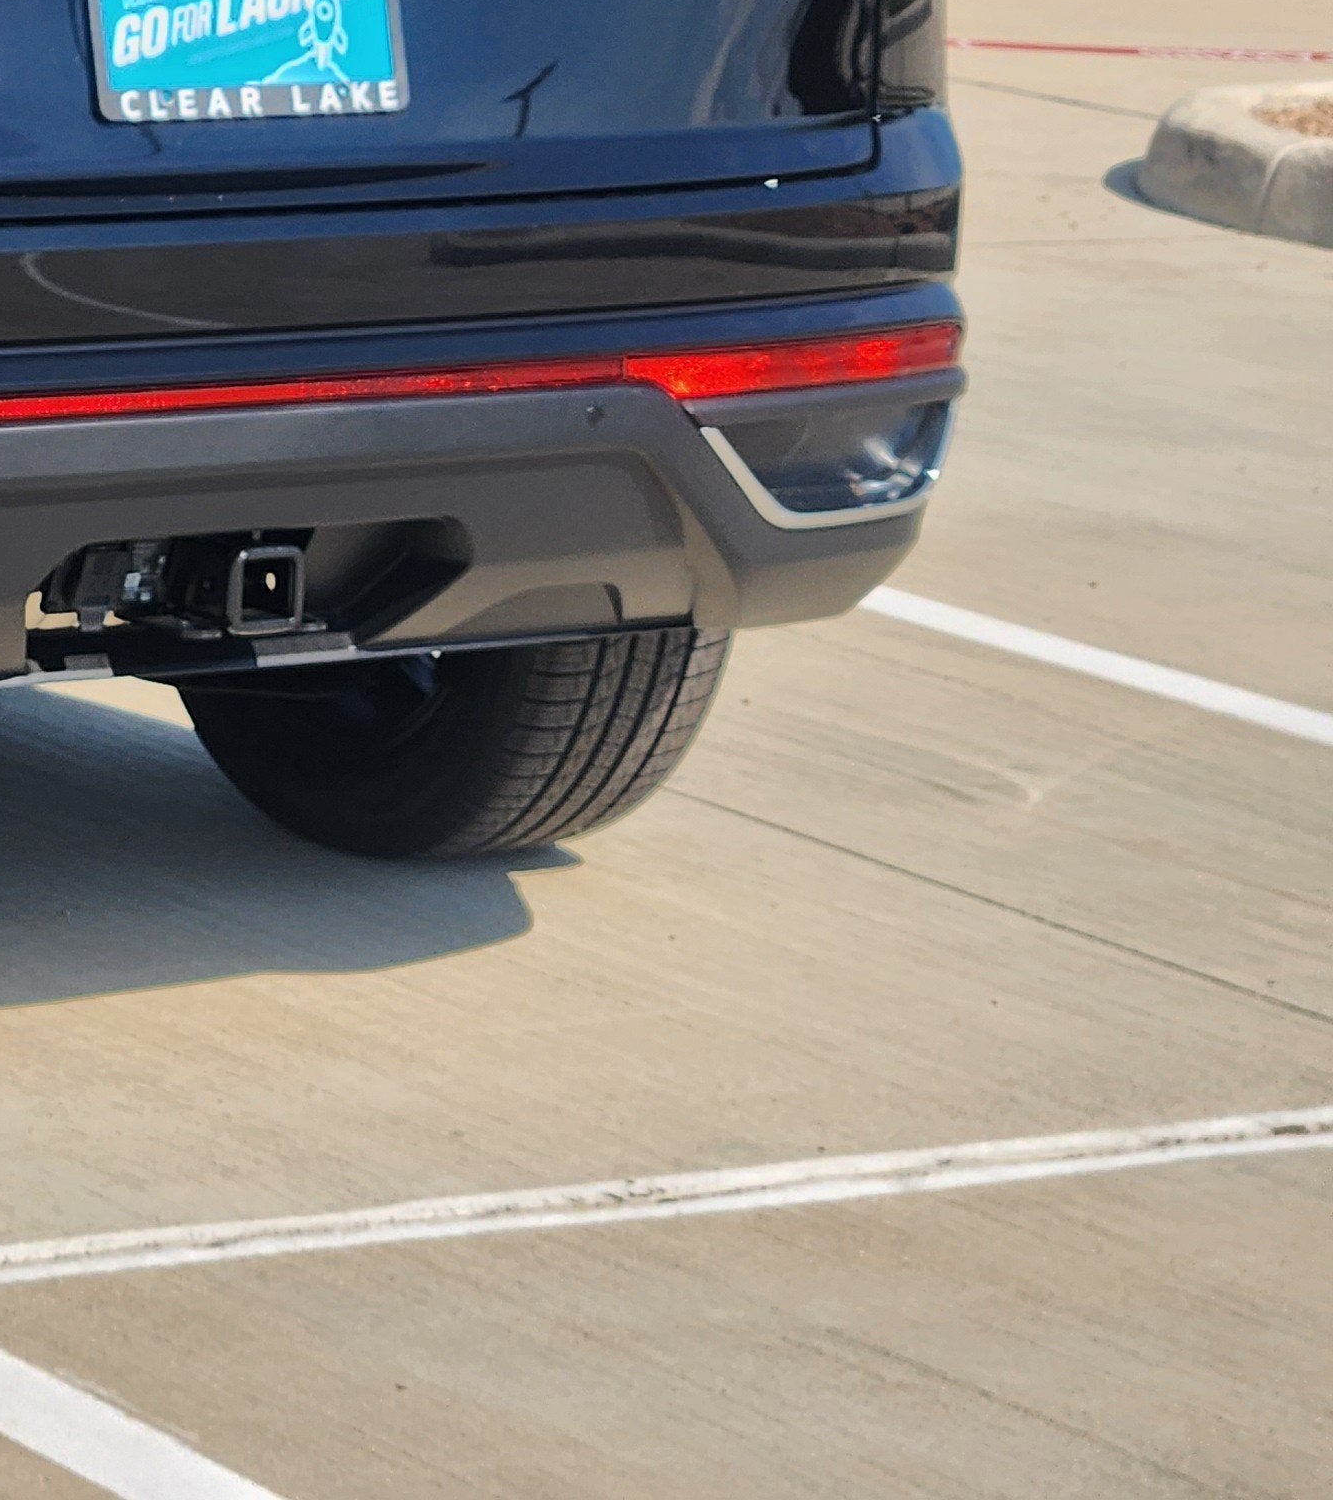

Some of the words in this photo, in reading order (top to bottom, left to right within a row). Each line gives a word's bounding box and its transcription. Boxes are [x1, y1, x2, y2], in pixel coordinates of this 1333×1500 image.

[113, 5, 169, 68] GO
[120, 87, 263, 123] CLEAR
[292, 79, 400, 114] LAKE
